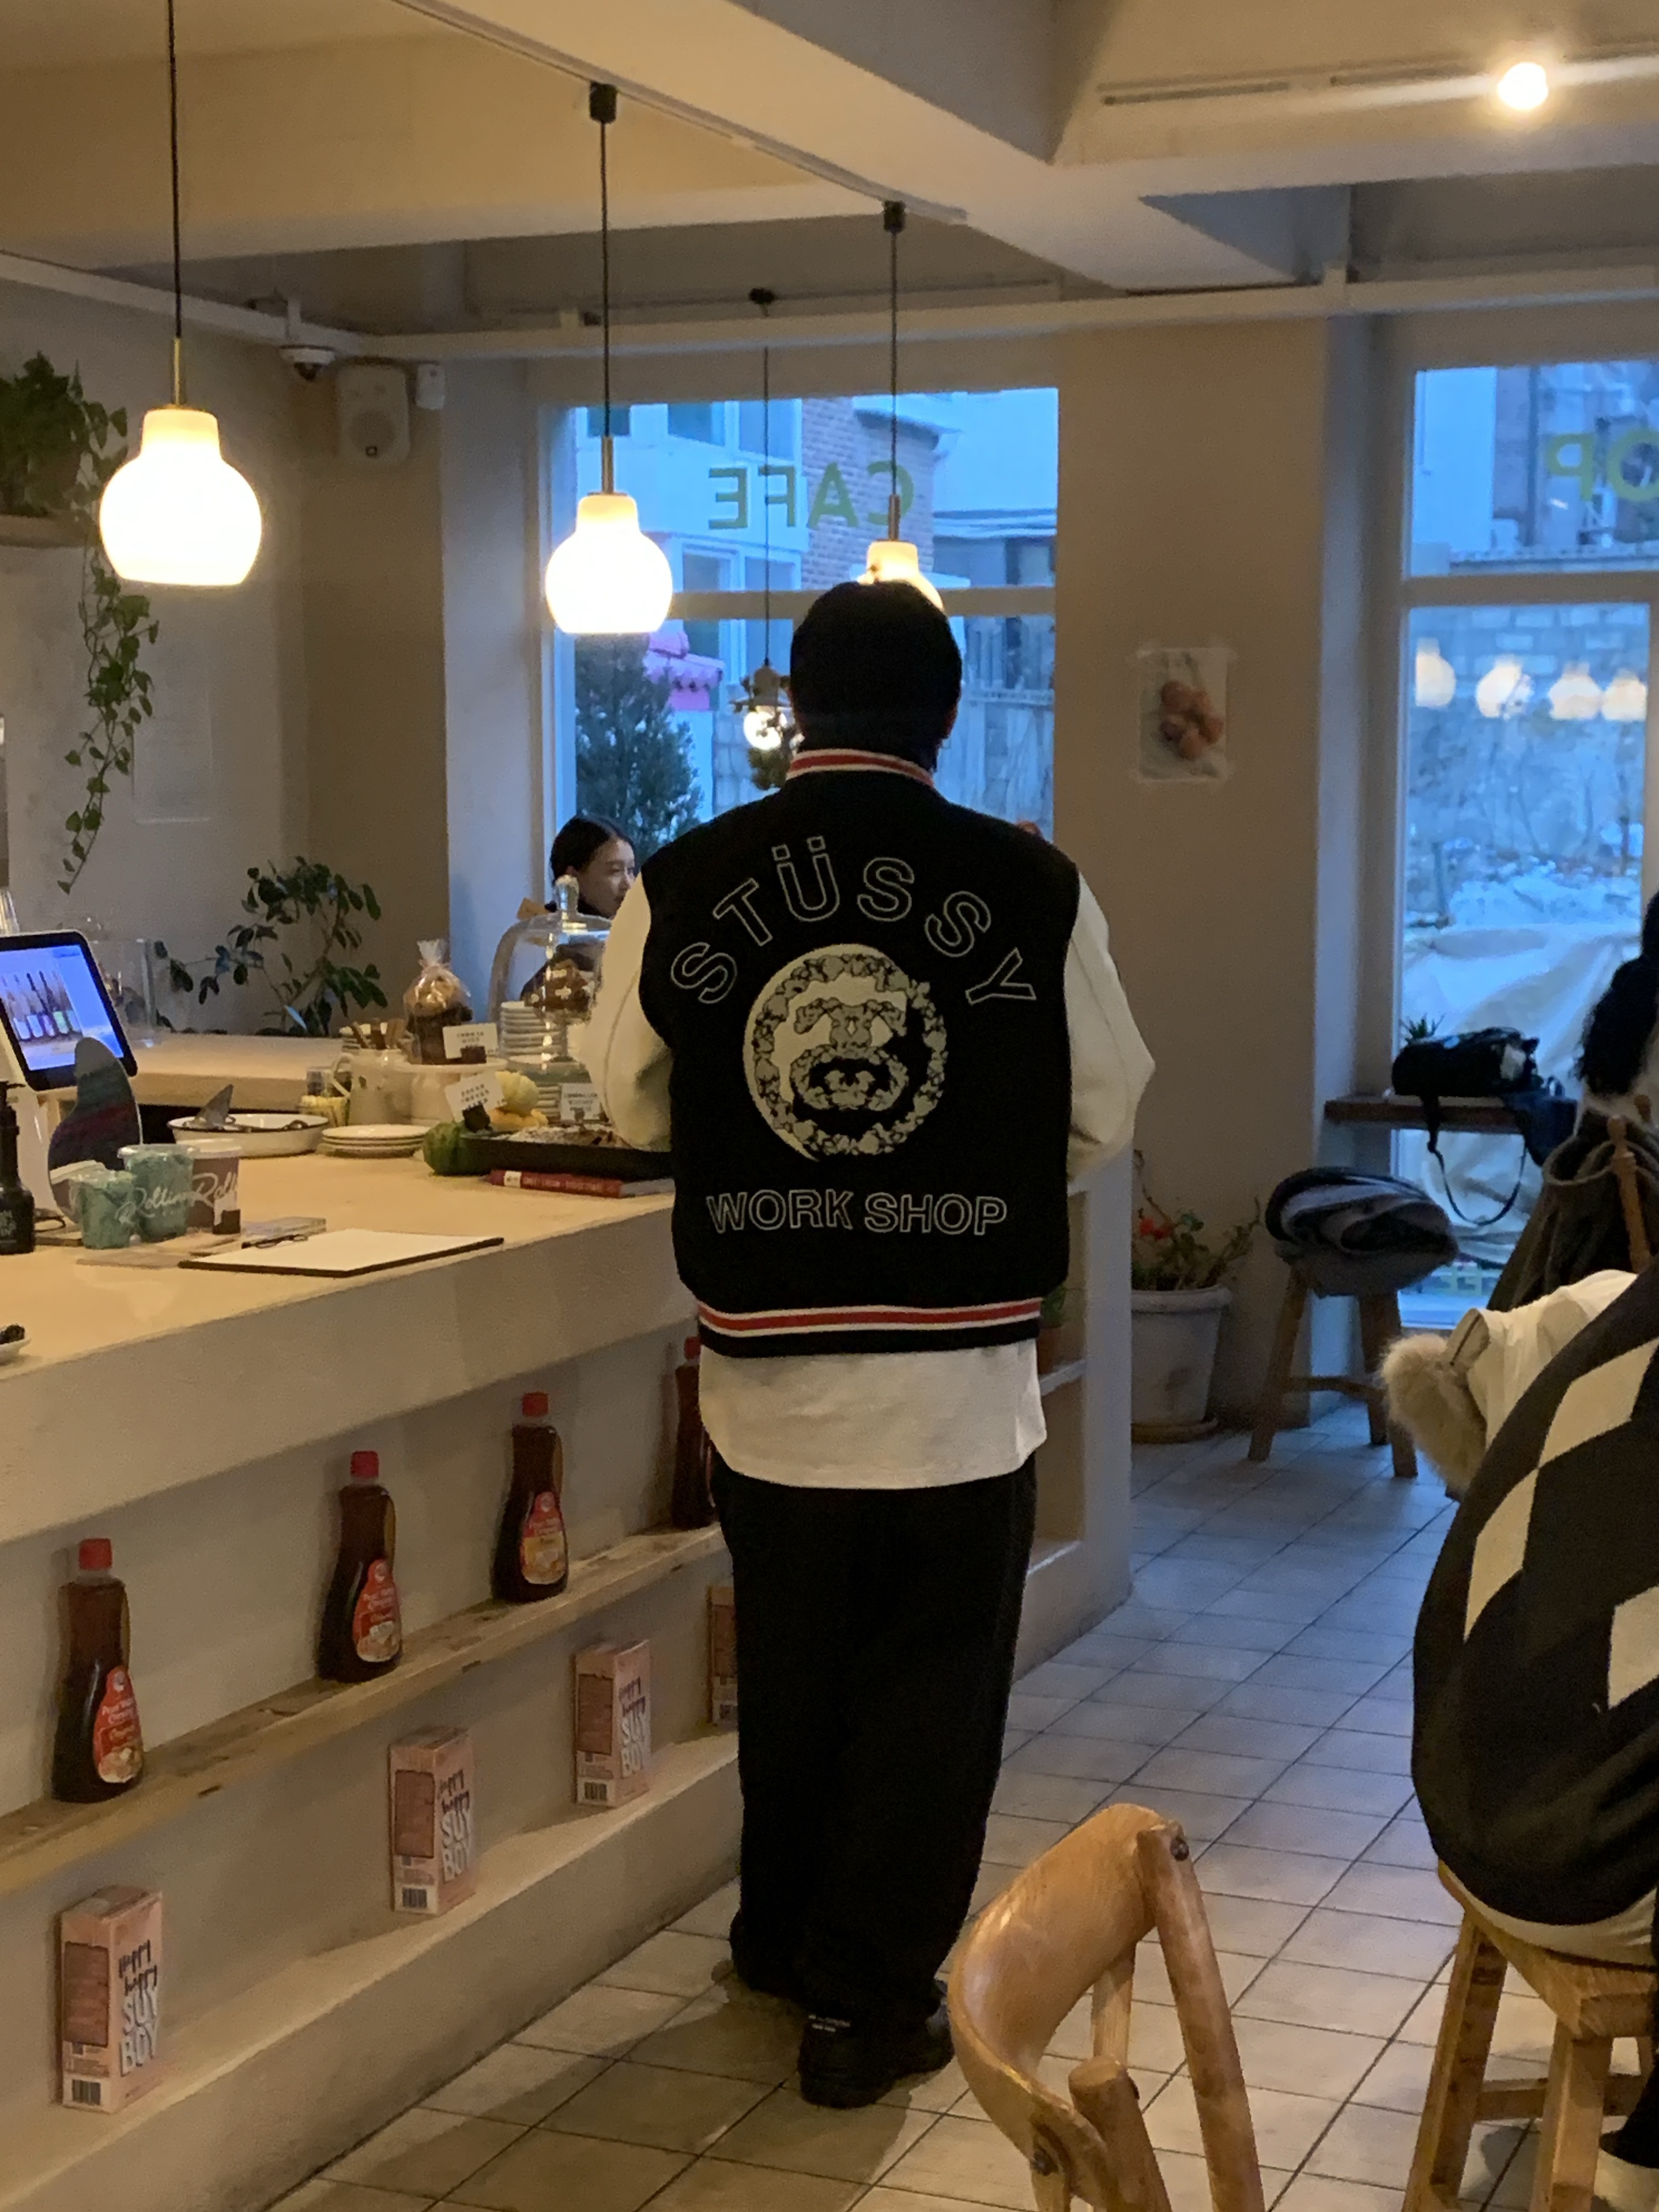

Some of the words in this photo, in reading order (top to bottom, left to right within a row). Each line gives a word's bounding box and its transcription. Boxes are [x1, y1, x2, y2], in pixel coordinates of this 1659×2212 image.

[670, 835, 1036, 1005] STÜSSY
[706, 1188, 854, 1233] WORK
[864, 1192, 1008, 1235] SHOP
